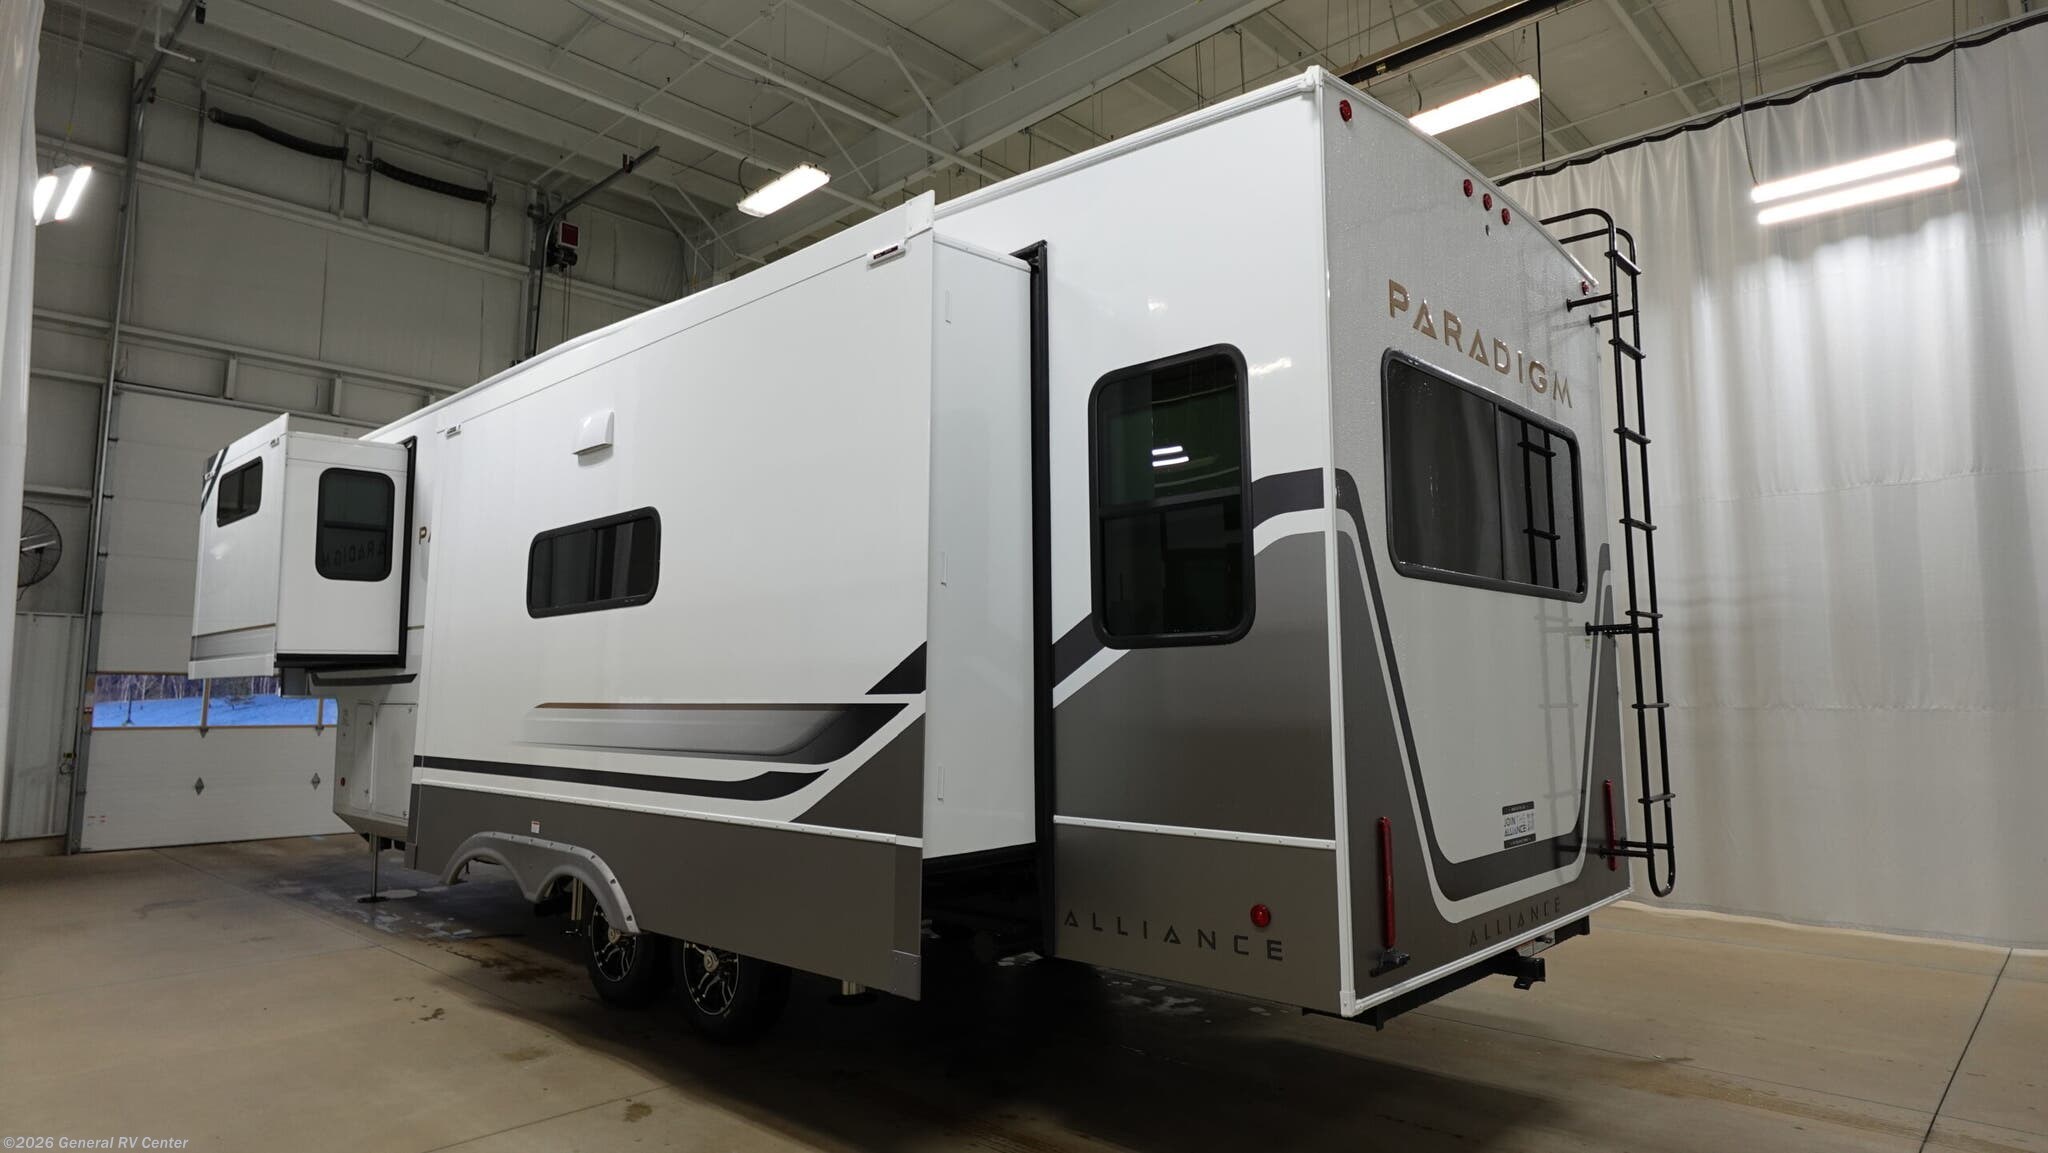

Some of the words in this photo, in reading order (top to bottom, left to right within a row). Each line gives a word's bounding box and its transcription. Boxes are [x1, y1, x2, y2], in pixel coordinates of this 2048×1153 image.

[1388, 278, 1573, 409] PARADIGM
[1064, 910, 1284, 961] ALLIANCE
[1469, 897, 1561, 947] ALLIANCE
